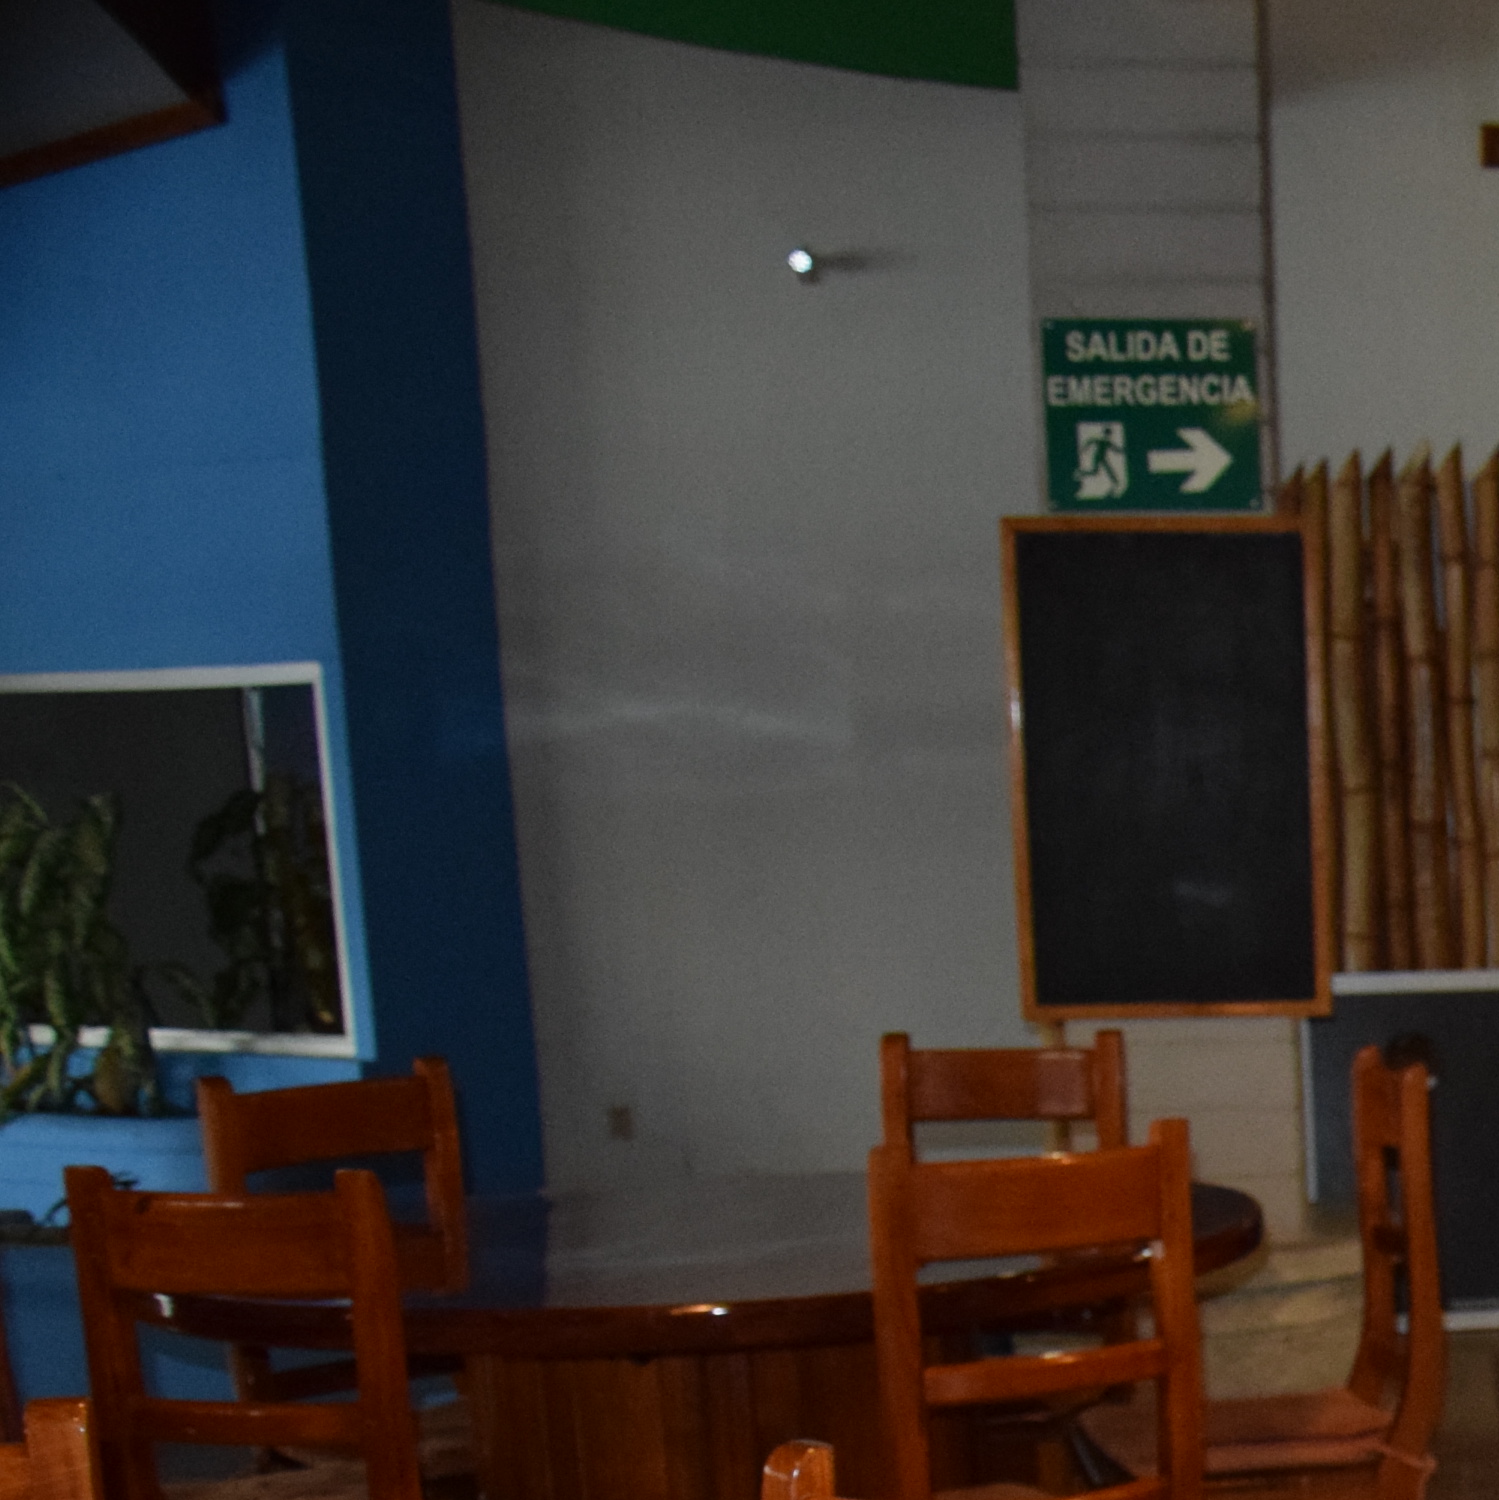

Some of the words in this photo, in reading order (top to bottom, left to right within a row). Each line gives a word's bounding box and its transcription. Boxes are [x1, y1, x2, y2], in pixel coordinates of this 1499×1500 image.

[1064, 329, 1181, 362] SALIDA
[1187, 329, 1231, 362] DE
[1047, 374, 1254, 406] EMERGENCIA
